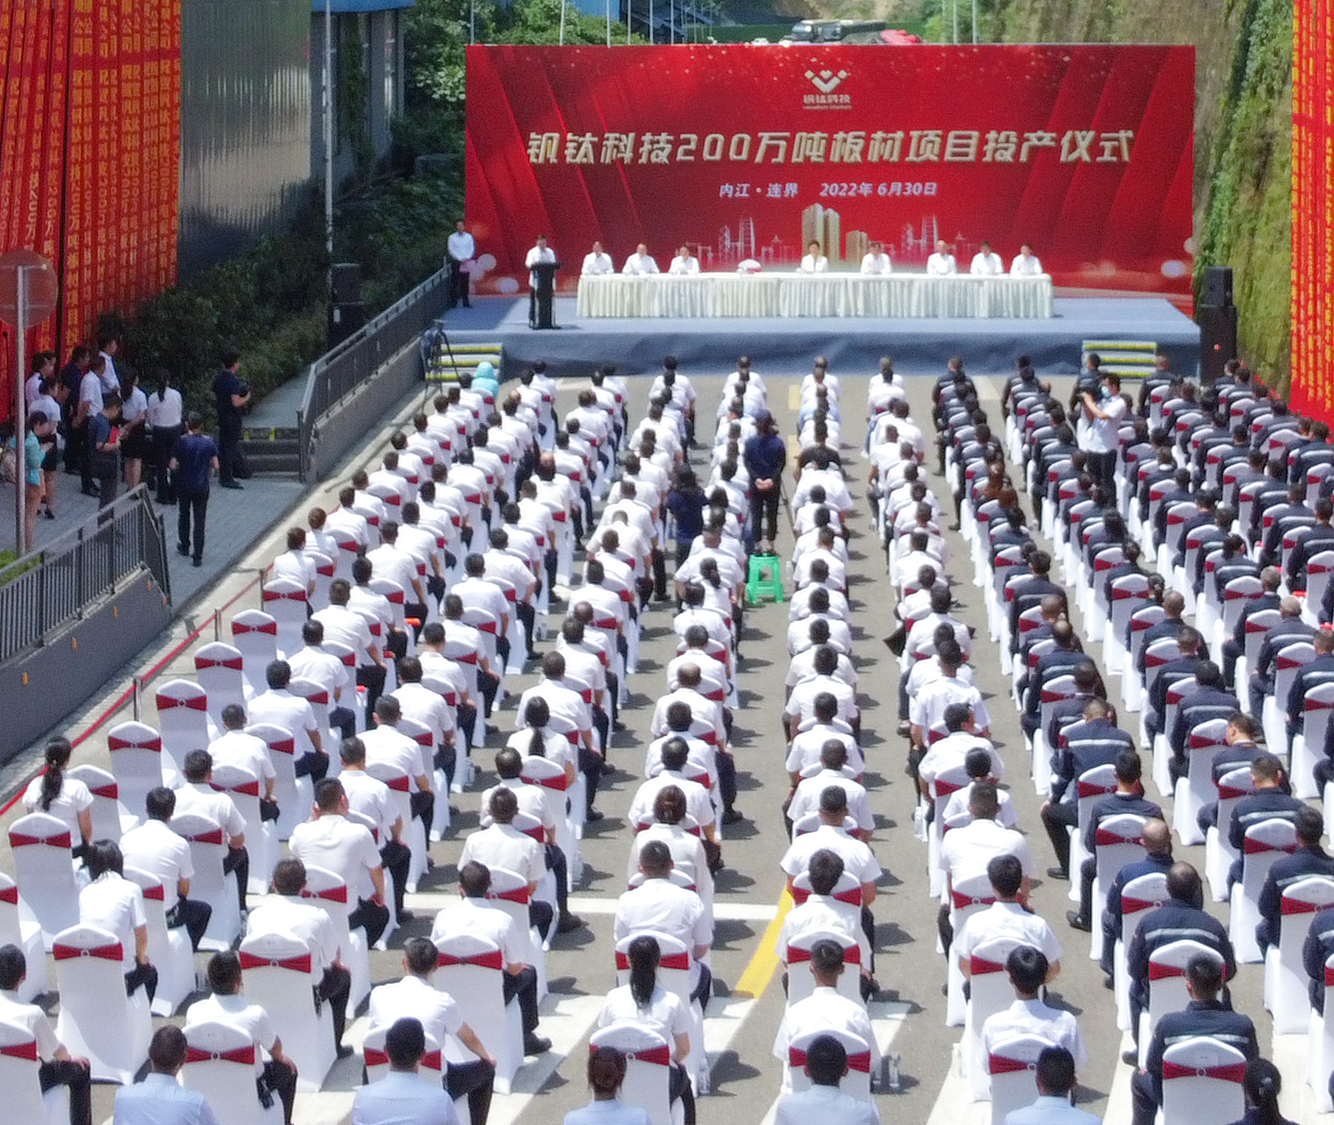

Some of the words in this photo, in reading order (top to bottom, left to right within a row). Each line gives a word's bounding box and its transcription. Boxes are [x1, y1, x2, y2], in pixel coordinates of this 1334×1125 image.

[527, 129, 1133, 165] 钒钛科技200万吨板材项目投产仪式
[819, 182, 873, 197] 2022年
[877, 182, 938, 196] 6月30日
